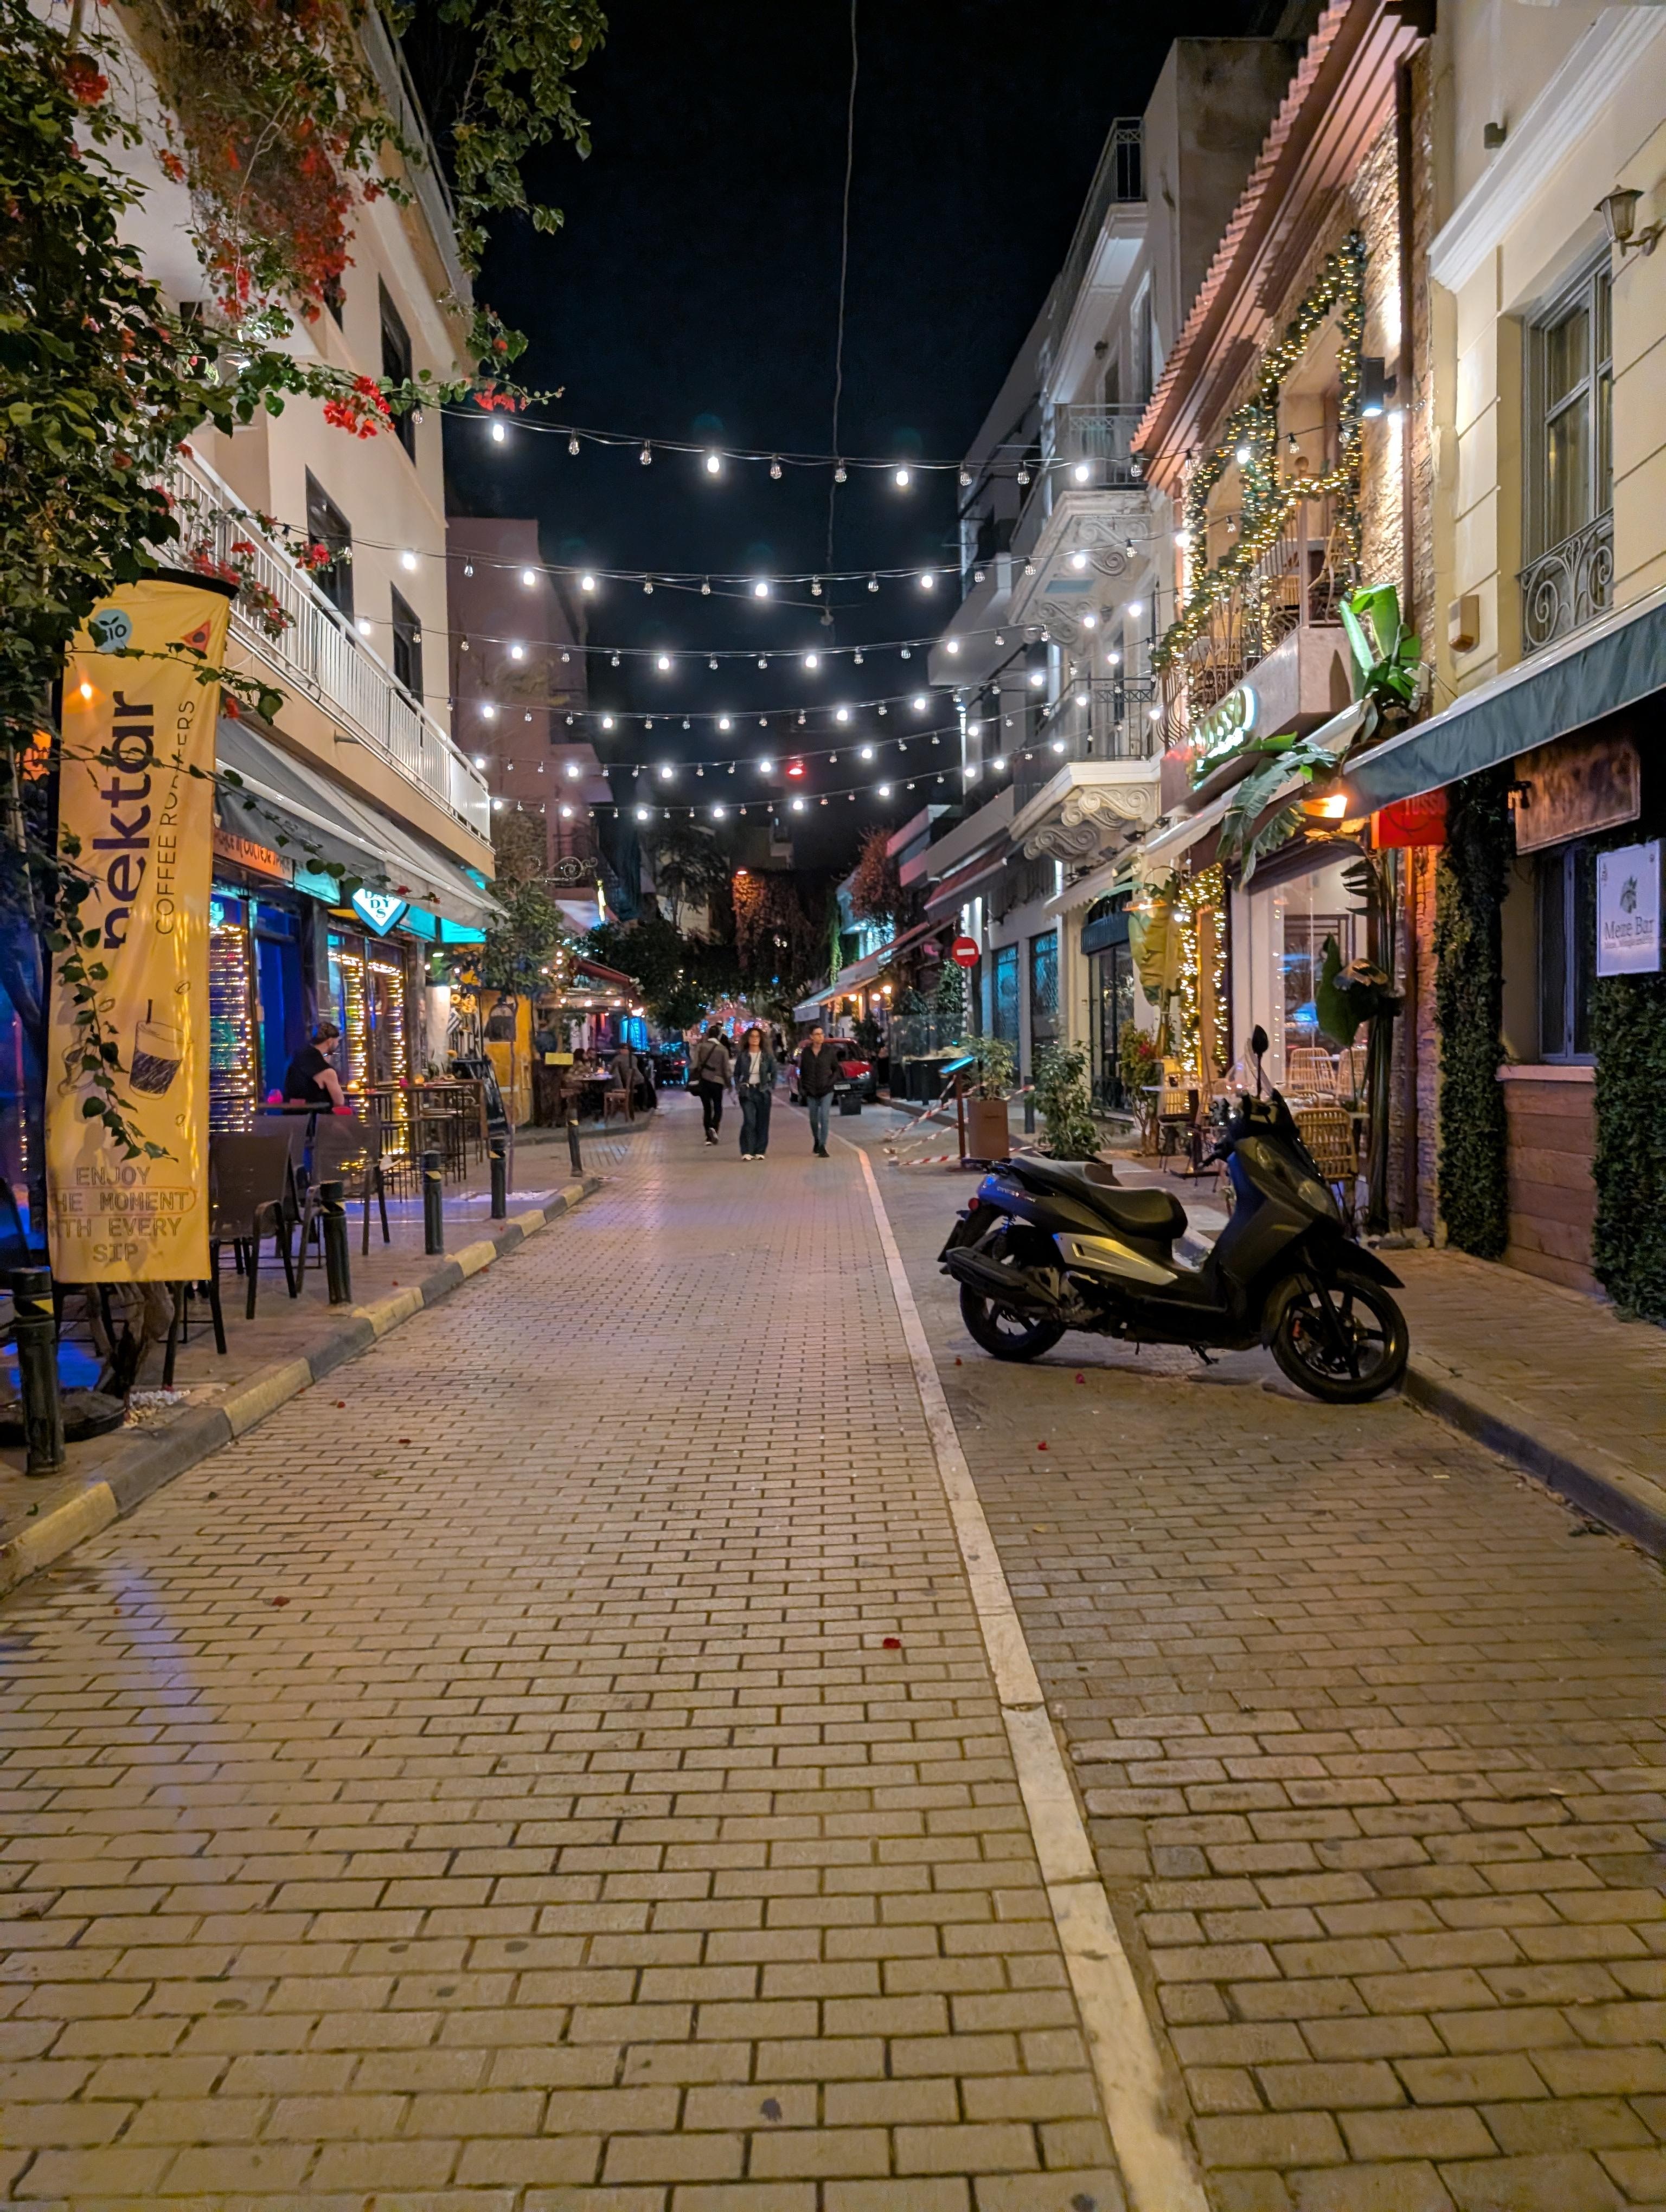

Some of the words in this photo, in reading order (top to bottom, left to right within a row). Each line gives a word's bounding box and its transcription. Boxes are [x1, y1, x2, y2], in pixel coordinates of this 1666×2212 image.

[93, 690, 154, 949] nektar
[155, 835, 177, 935] COFFEE
[1635, 916, 1654, 935] Bar
[75, 1166, 150, 1186] ENJOY
[99, 1191, 189, 1212] MOMENT
[108, 1217, 182, 1237] EVERY
[92, 1243, 138, 1263] SIP
